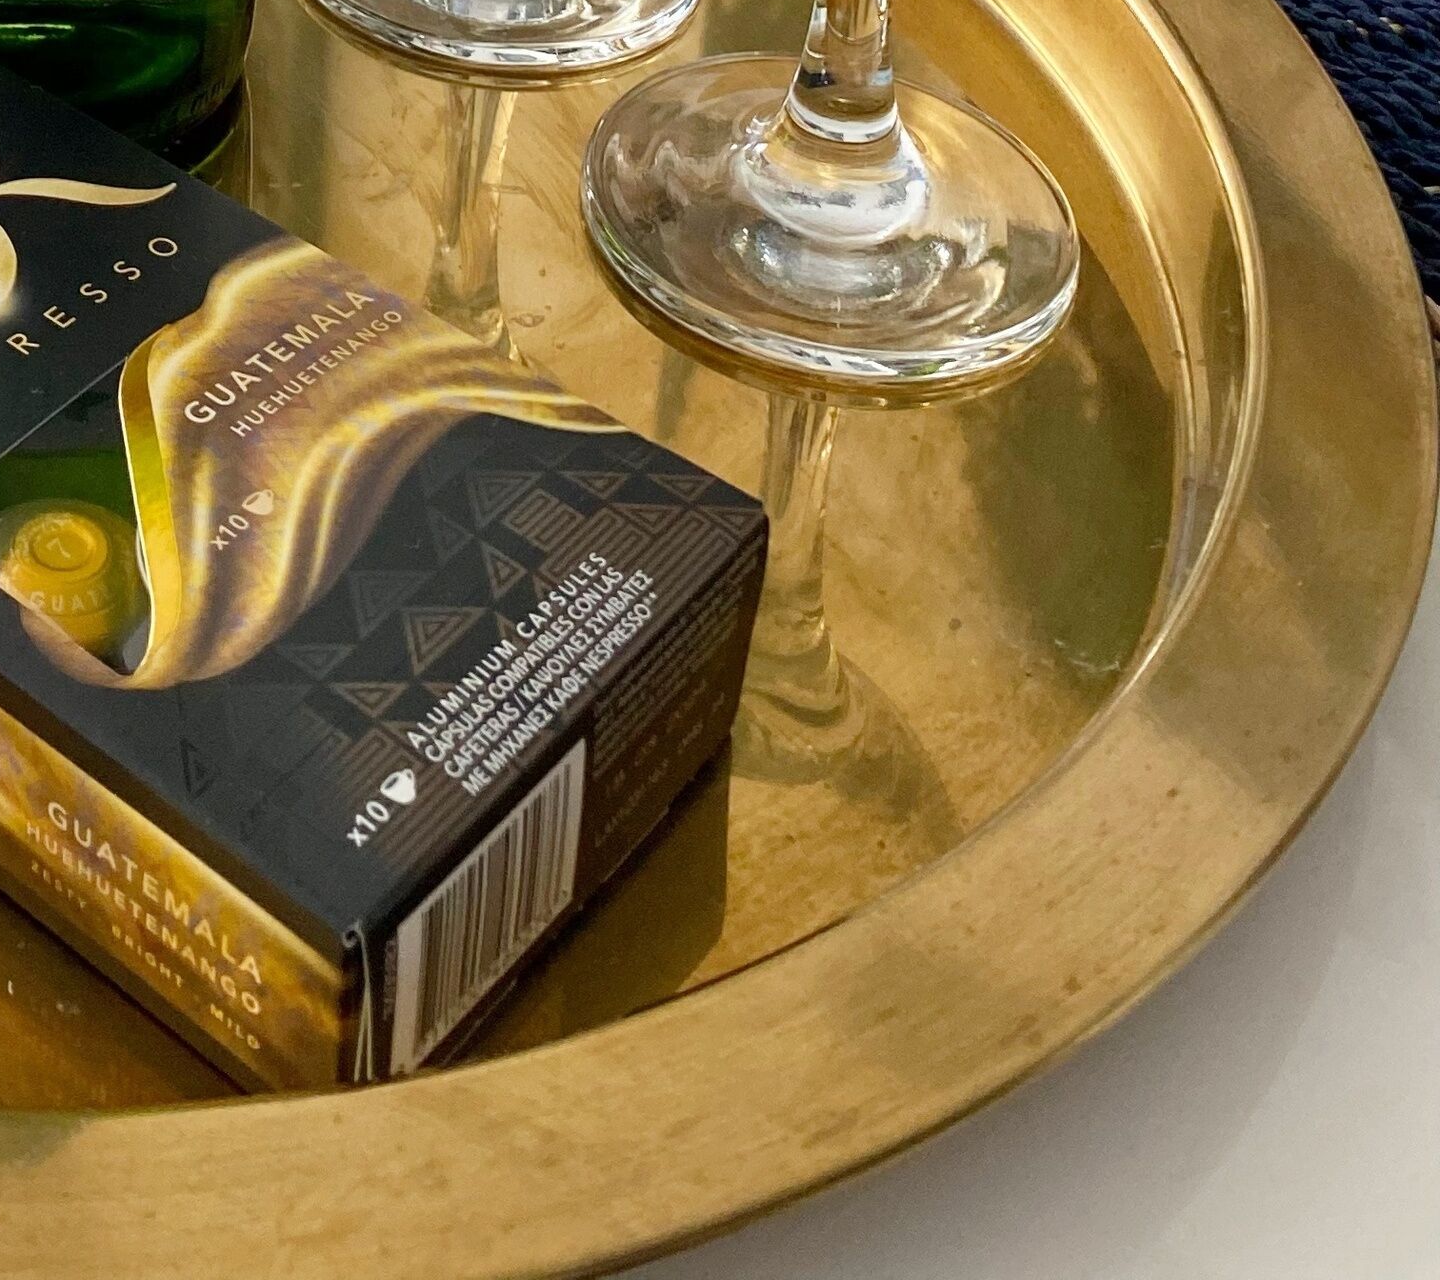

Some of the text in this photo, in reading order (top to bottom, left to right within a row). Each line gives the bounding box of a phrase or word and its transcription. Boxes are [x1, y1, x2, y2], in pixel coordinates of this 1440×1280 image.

[184, 290, 375, 424] GUATEMALA
[229, 310, 402, 438] HUEHUETENANGO
[406, 639, 518, 749] ALUMINIUM
[516, 552, 607, 639] CAPSULES
[424, 566, 623, 763] CAPSULAS COMPATIBLES CON LAS
[444, 703, 521, 778] CAFETERAS
[26, 821, 260, 1015] HUEHUETENANGO
[47, 801, 262, 985] GUATEMALA
